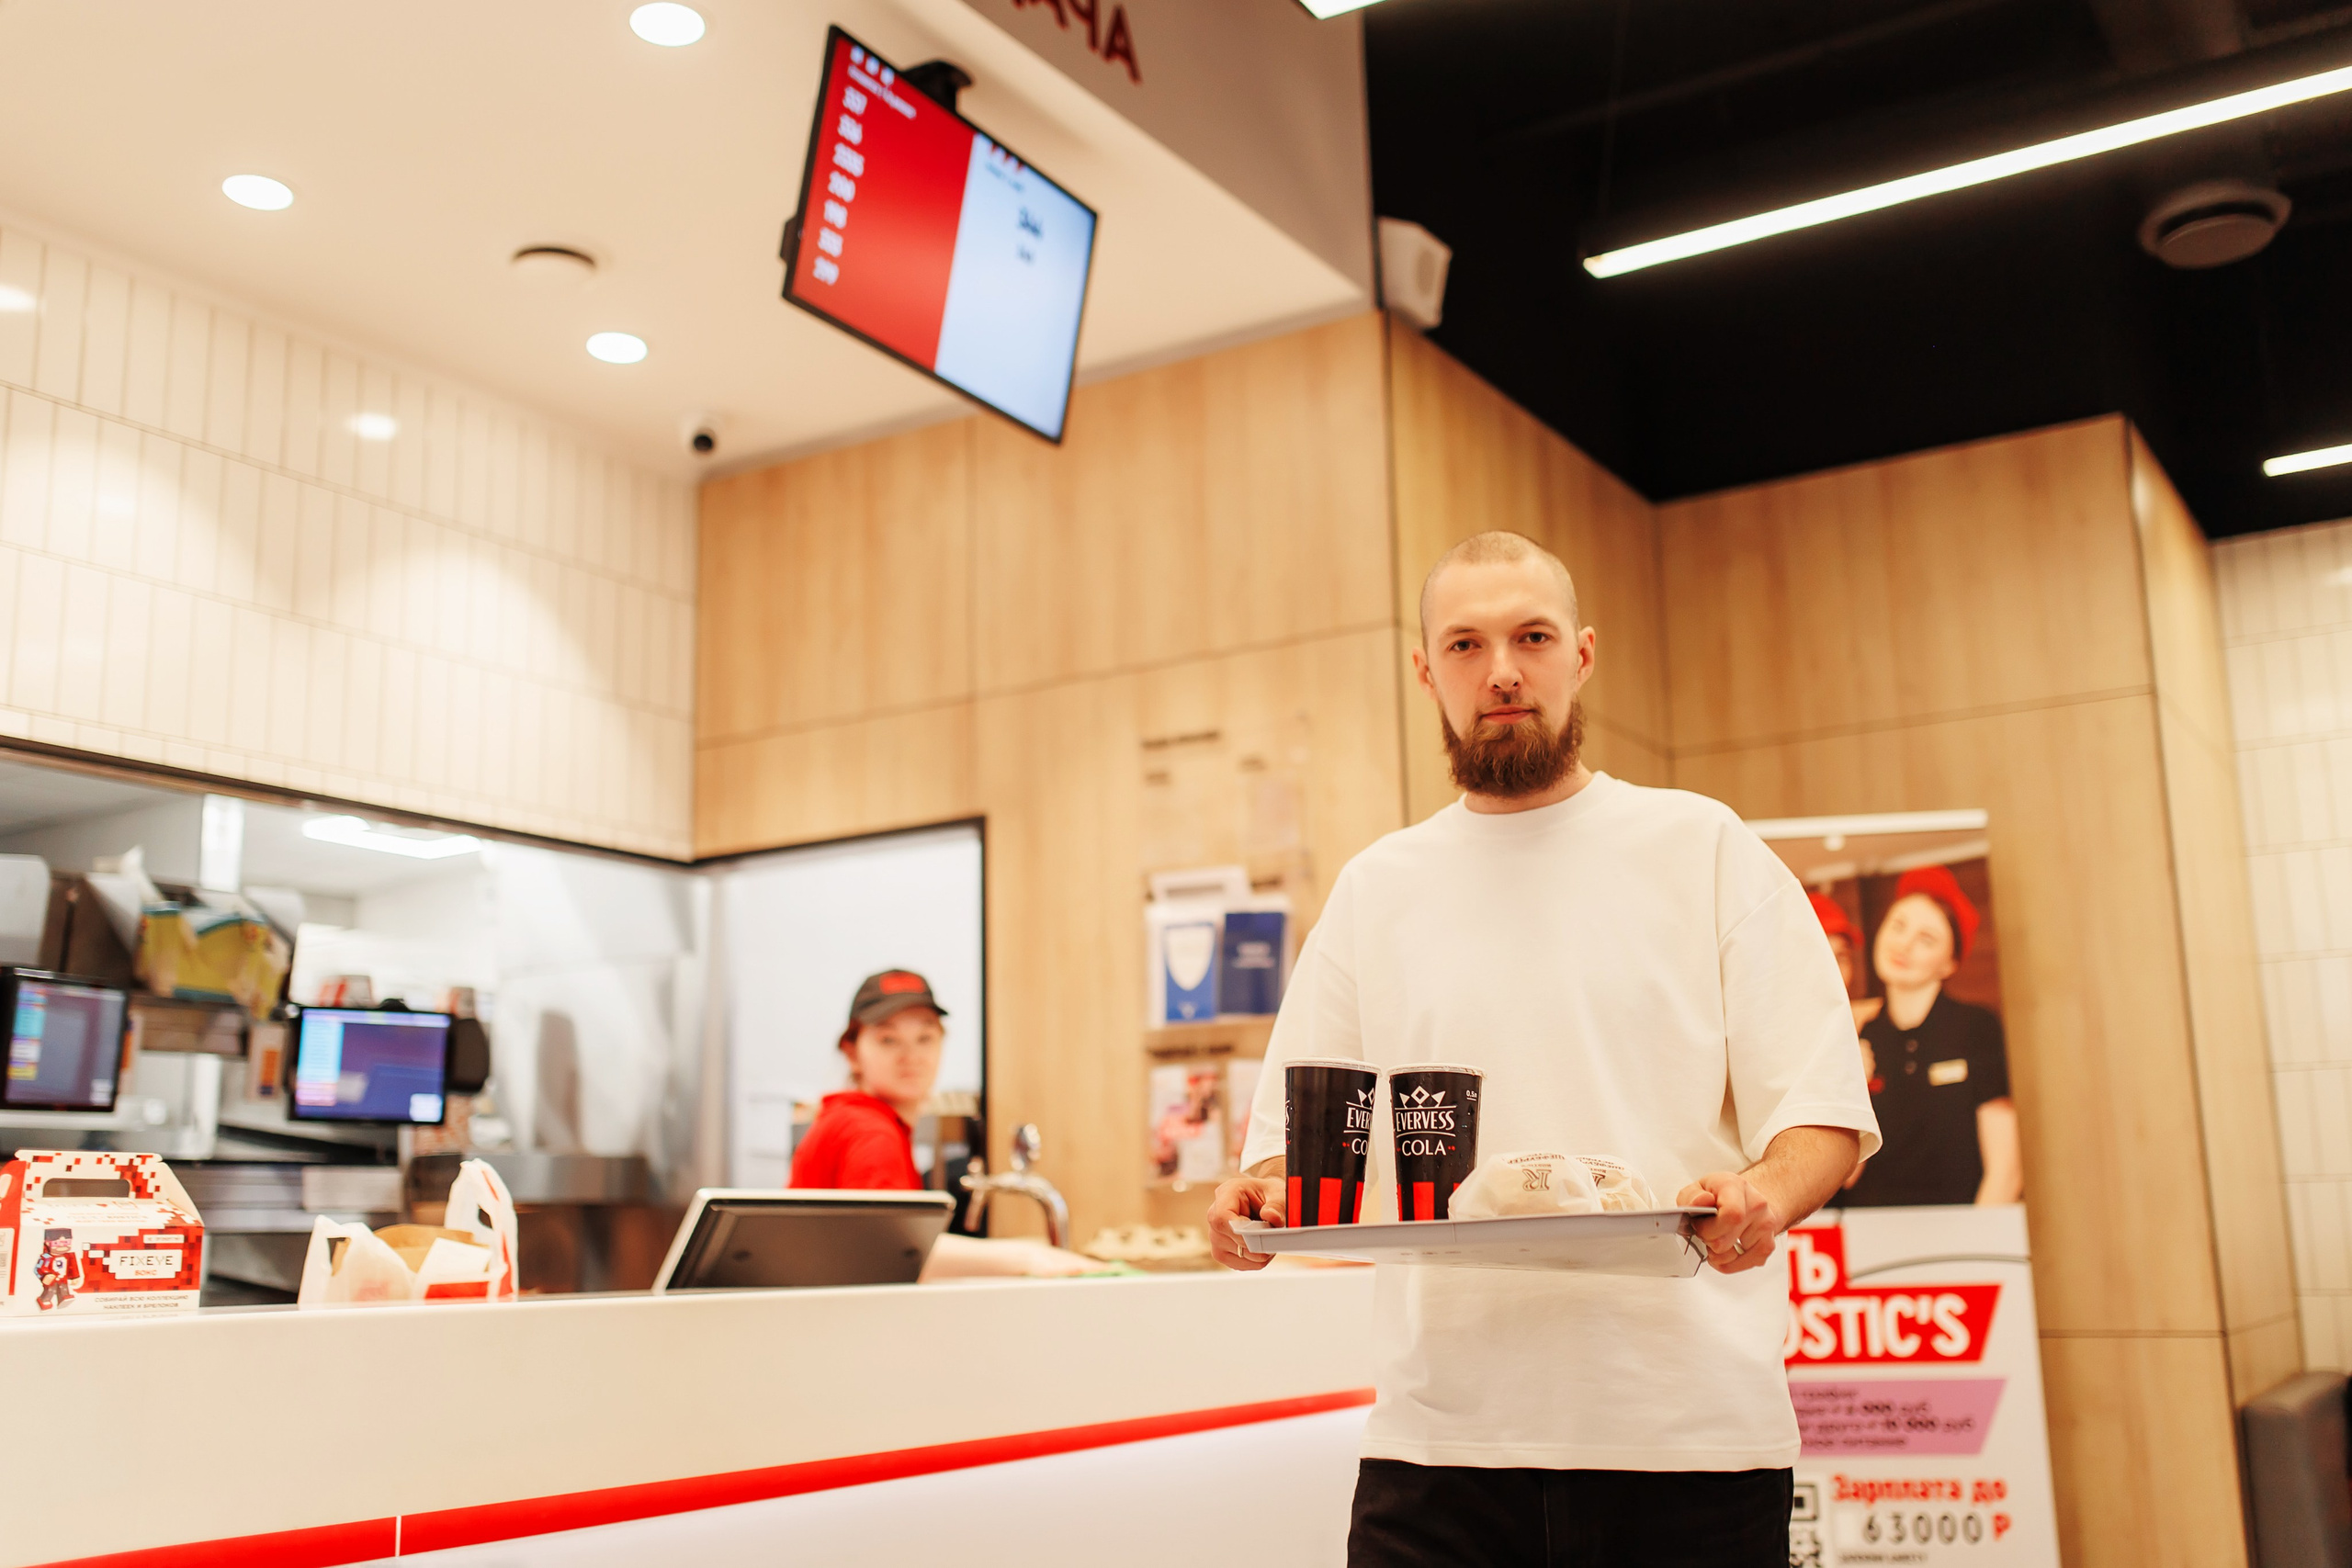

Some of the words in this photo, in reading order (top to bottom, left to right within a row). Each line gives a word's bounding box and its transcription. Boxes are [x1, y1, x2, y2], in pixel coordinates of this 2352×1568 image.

[1396, 1111, 1455, 1132] EVERVESS
[1401, 1139, 1447, 1156] COLA
[1521, 1168, 1553, 1192] R
[119, 1256, 174, 1267] FIXEYE
[1831, 1475, 1962, 1509] Зарплата
[1972, 1478, 2008, 1506] до
